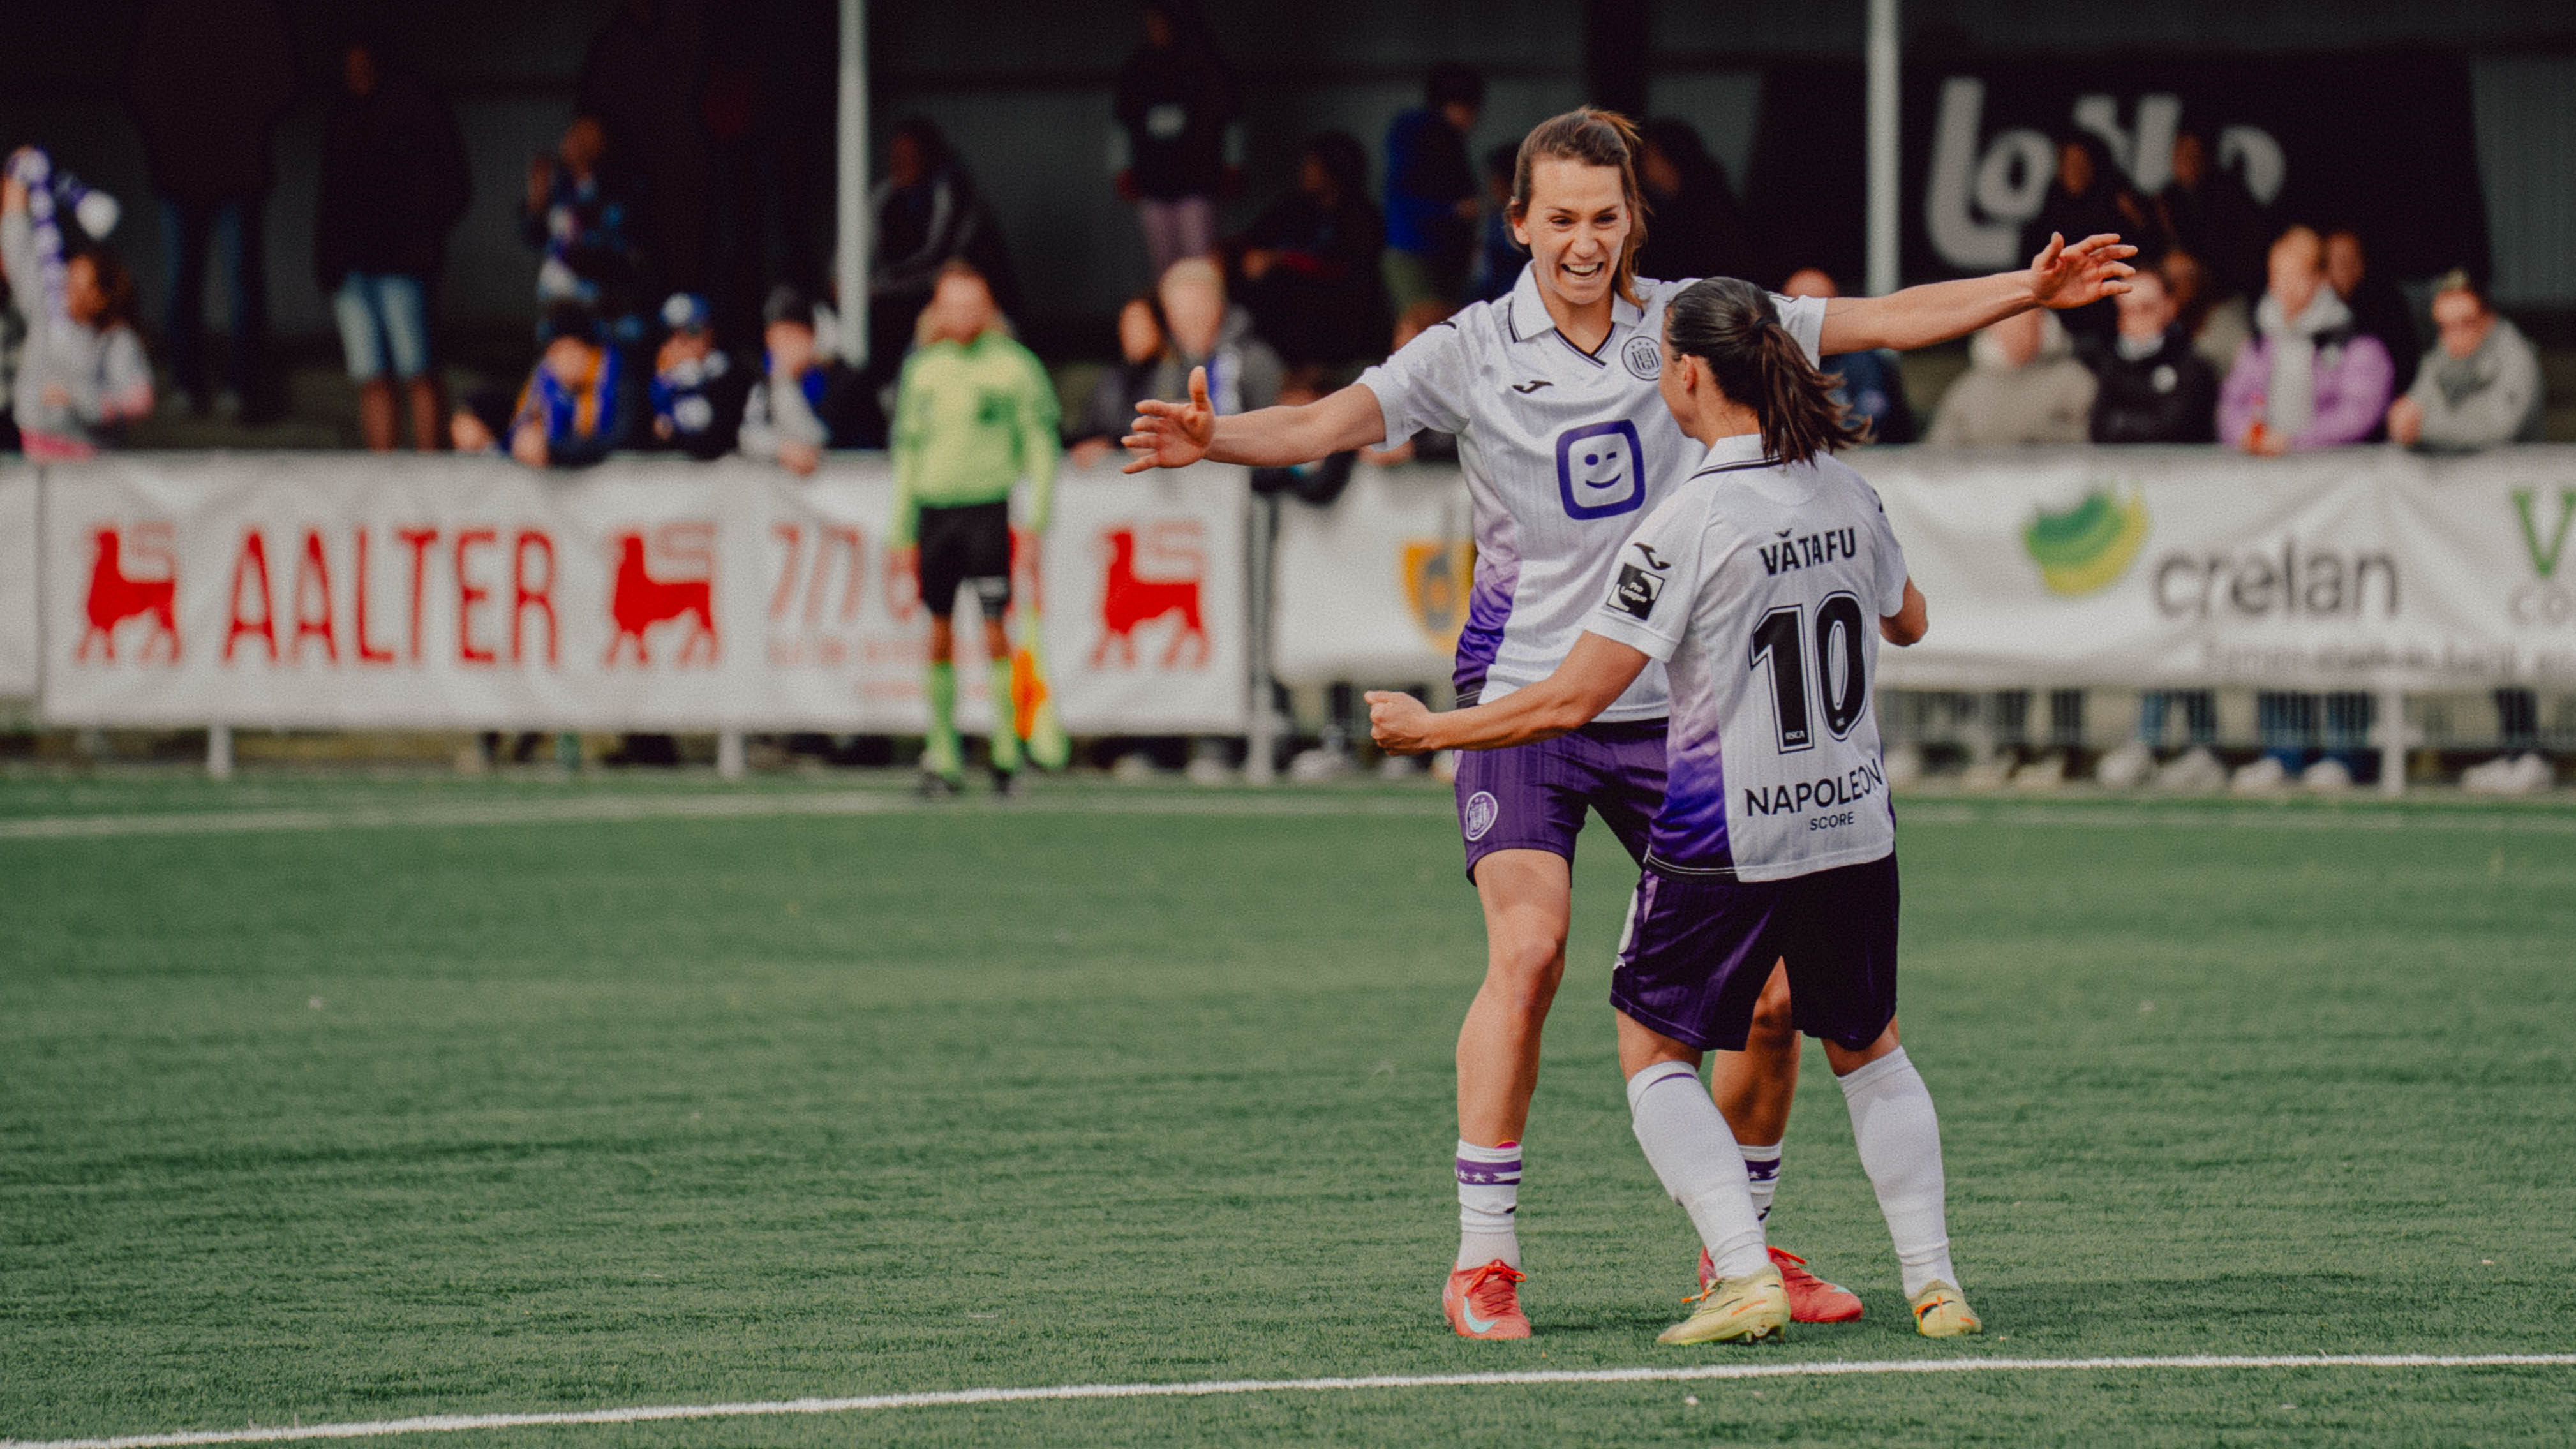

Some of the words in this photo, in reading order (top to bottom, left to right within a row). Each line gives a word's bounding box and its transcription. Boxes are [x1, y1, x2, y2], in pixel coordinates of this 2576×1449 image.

[1759, 527, 1856, 576] VĂTAFU
[2154, 540, 2398, 616] crelan
[221, 523, 558, 665] AALTER
[1620, 586, 1648, 603] League
[1630, 582, 1644, 593] Pro
[1749, 590, 1868, 754] 10
[1745, 757, 1883, 817] NAPOLEON
[1809, 811, 1855, 831] SCORE
